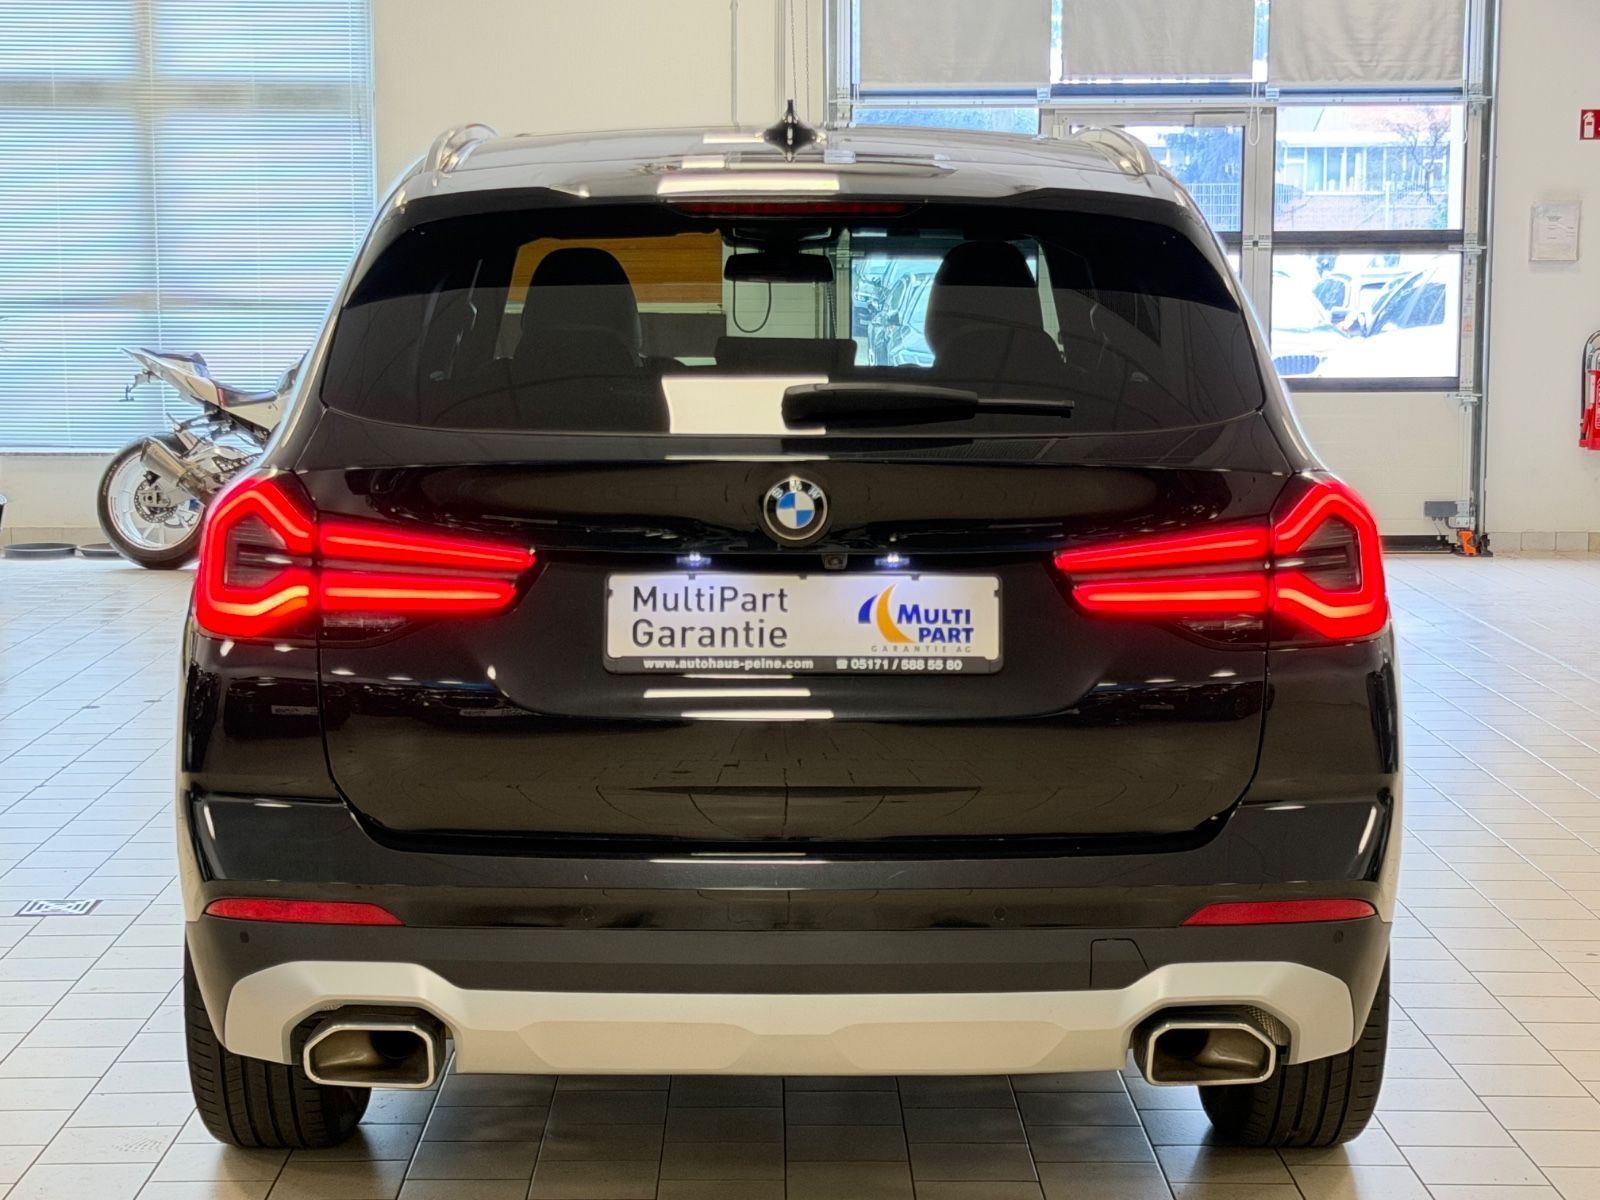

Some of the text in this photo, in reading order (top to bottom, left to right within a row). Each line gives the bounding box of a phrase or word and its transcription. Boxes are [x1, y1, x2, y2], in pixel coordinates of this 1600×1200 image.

[633, 585, 788, 612] MultiPart
[897, 604, 971, 625] MULTI
[632, 619, 788, 648] Garantie
[918, 627, 974, 643] PART
[871, 645, 972, 653] GARANTIE AG
[643, 658, 814, 671] www.autohaus-peine.com
[850, 658, 889, 670] 05171
[946, 658, 963, 670] 80
